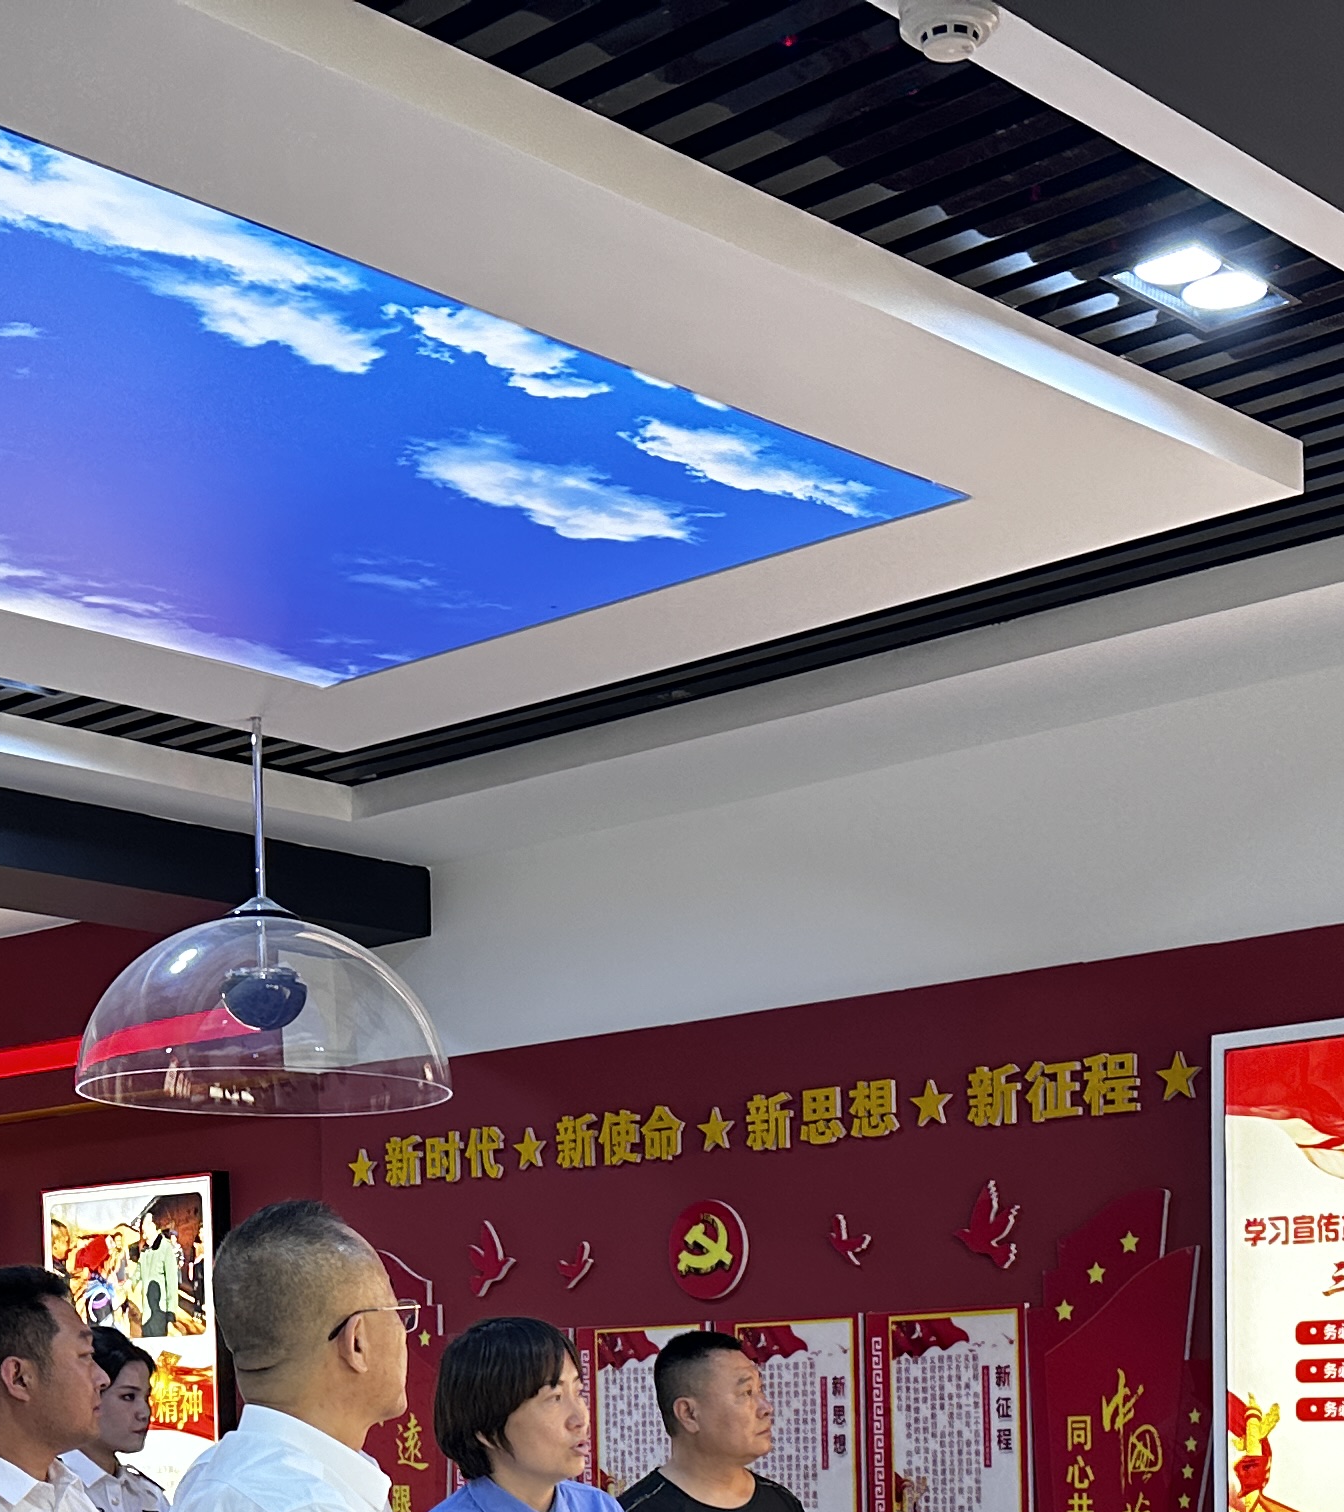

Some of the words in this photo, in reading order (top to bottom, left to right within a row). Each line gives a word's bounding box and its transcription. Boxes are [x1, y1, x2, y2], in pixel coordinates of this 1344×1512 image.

[384, 1126, 505, 1187] 新时代
[555, 1105, 686, 1170] 新使命
[745, 1079, 901, 1152] 新思想
[966, 1052, 1142, 1128] 新征程
[149, 1383, 203, 1430] 精神
[831, 1376, 847, 1454] 新思想
[995, 1364, 1013, 1452] 新征程
